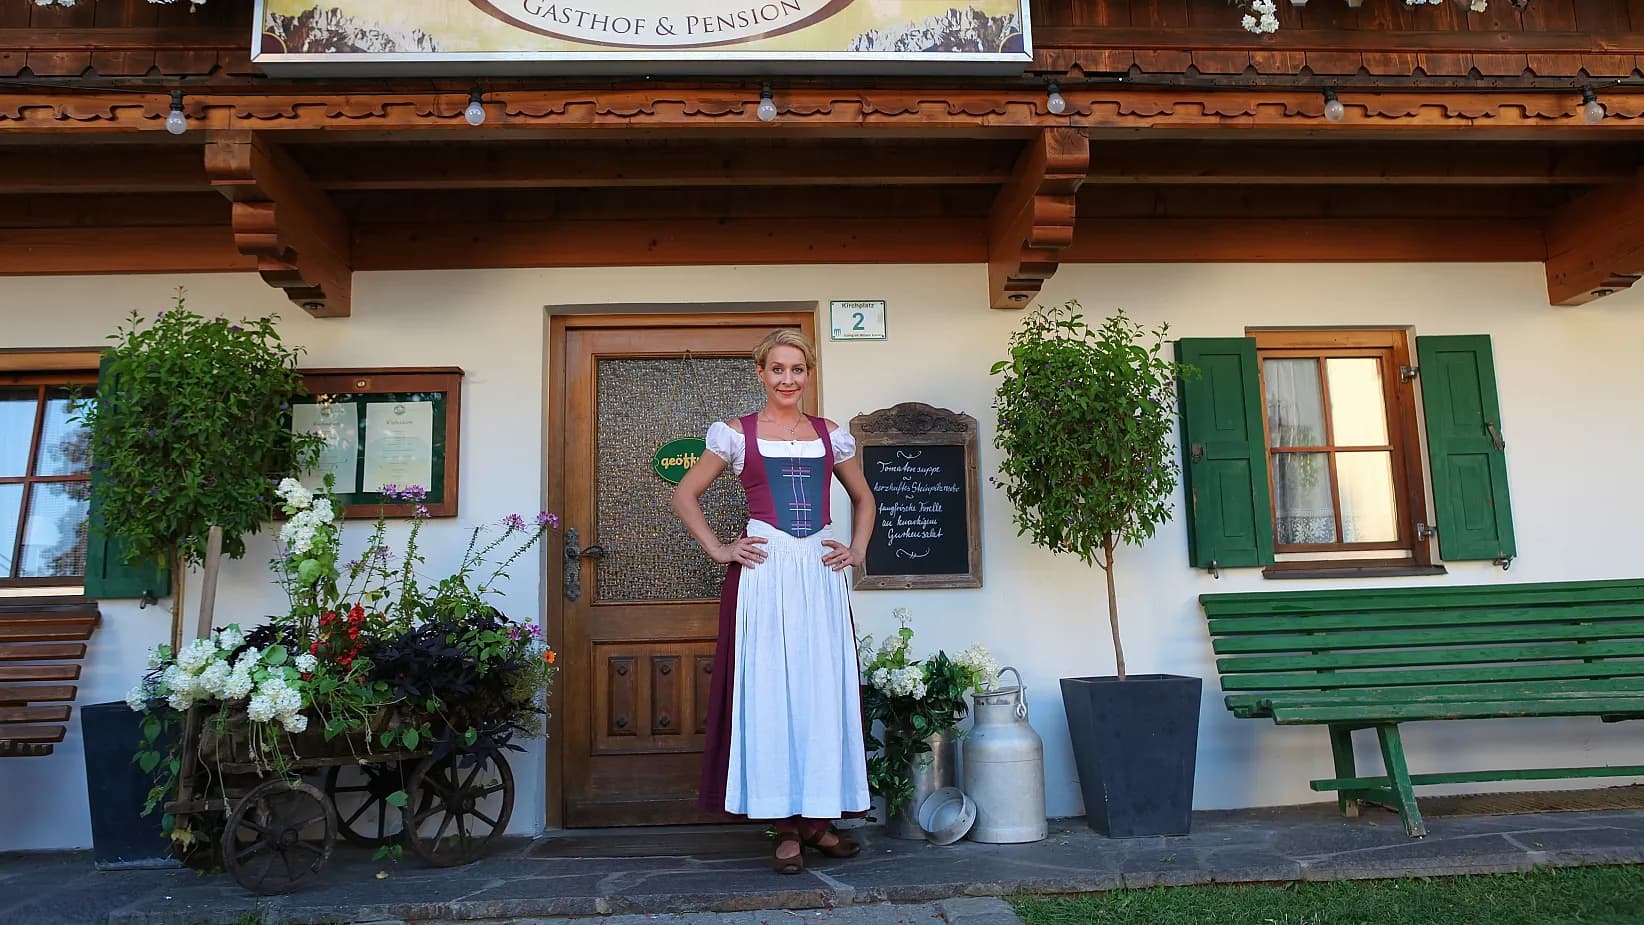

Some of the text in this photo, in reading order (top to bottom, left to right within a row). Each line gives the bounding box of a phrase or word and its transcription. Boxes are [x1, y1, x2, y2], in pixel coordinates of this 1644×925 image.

[523, 0, 801, 36] GASTHOF & PENSION
[852, 312, 865, 331] 2
[877, 461, 941, 476] Tomatensuppe
[887, 527, 944, 546] Gurkensalat
